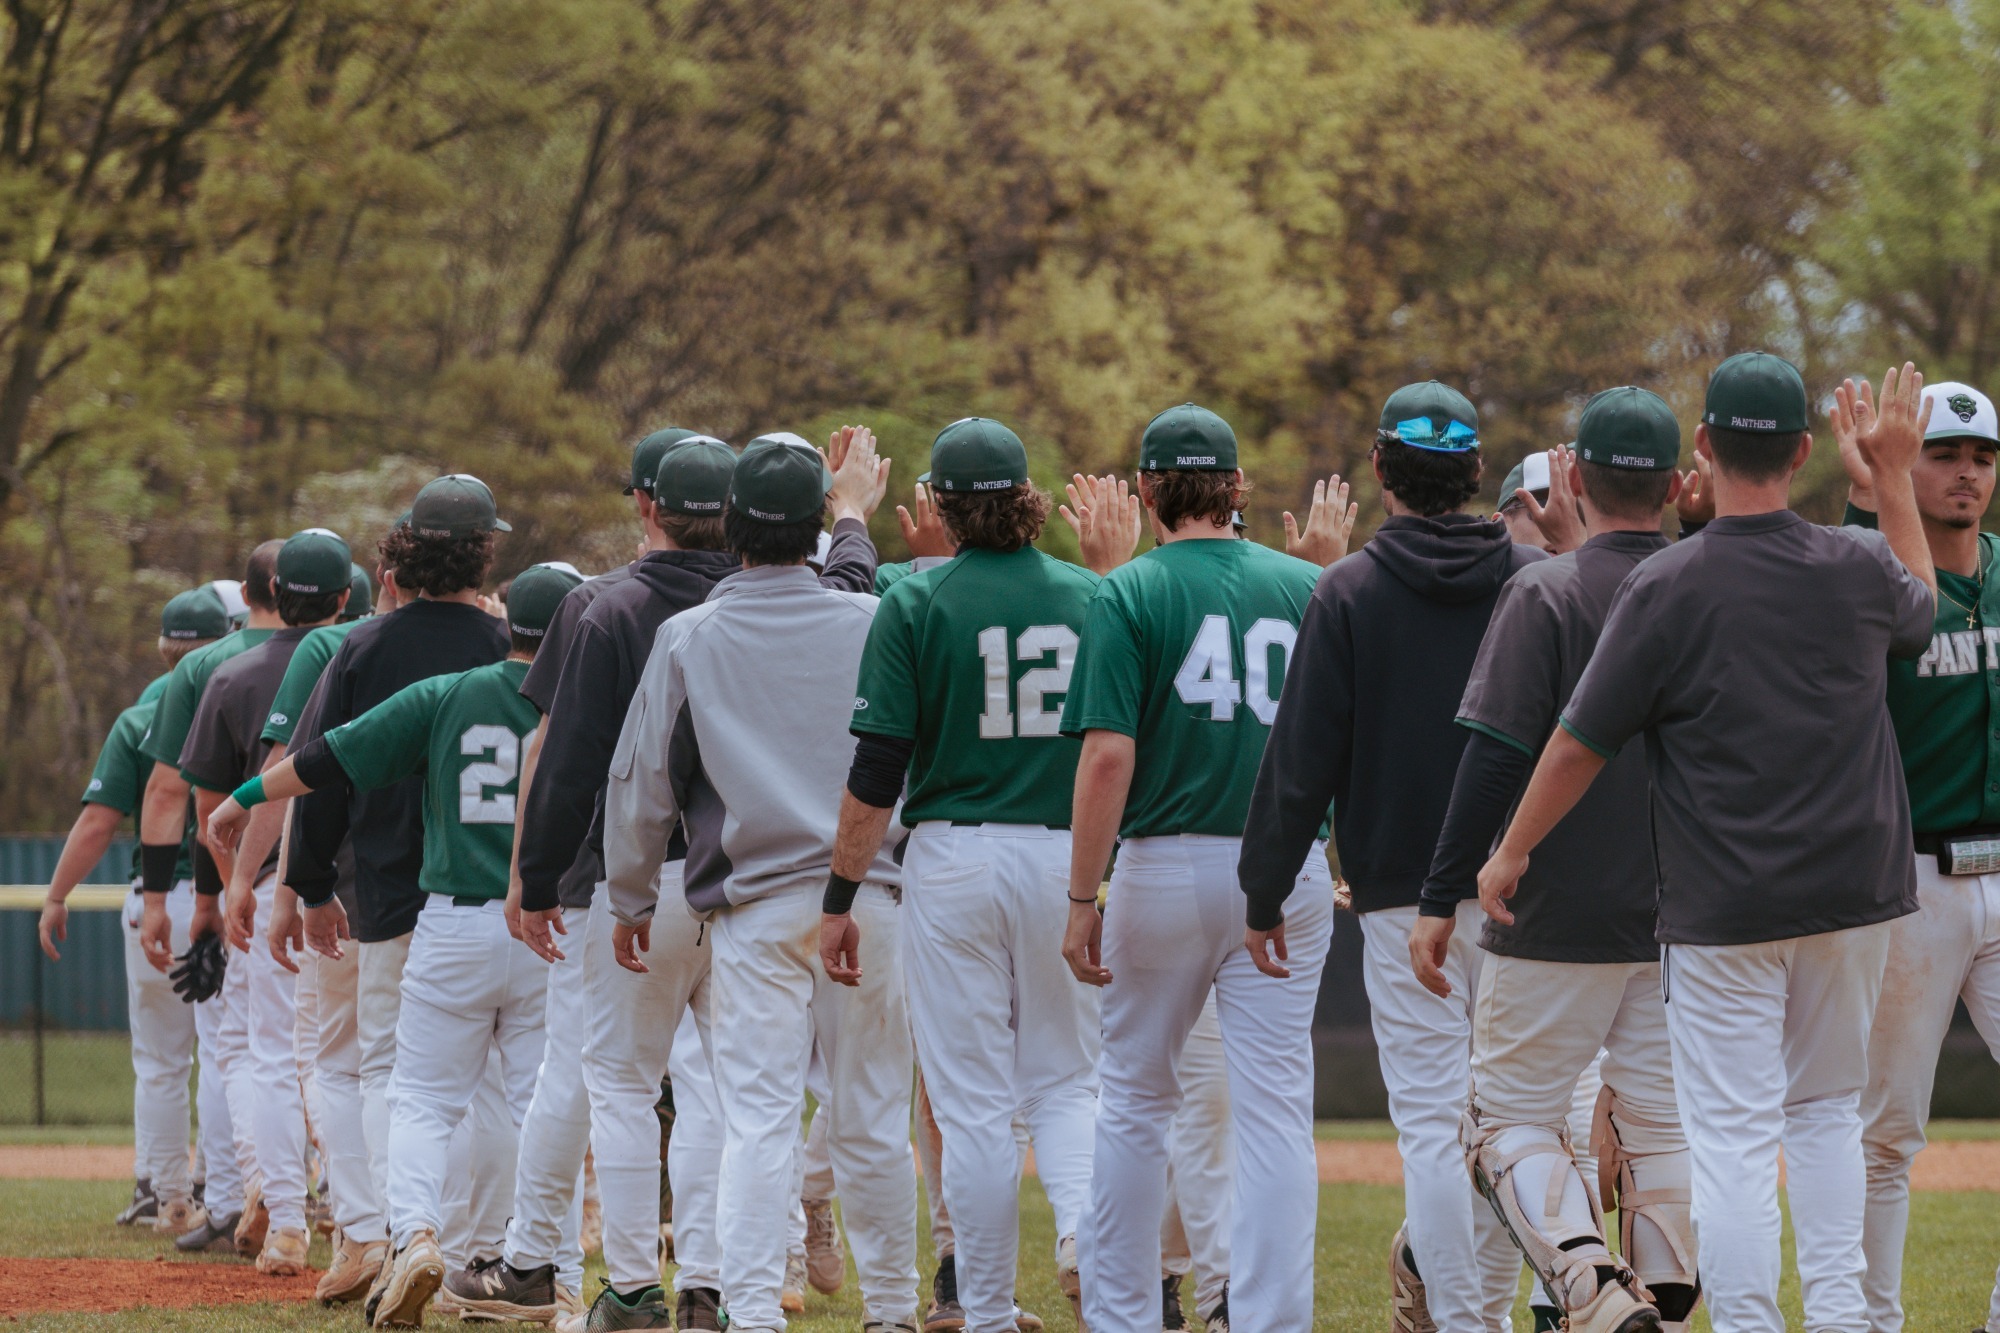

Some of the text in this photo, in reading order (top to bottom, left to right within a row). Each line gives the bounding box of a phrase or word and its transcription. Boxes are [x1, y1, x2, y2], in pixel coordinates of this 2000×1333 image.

[1731, 416, 1777, 429] PANTHERS
[1176, 456, 1217, 465] PANTHERS
[1612, 454, 1655, 467] PANTHERS
[973, 479, 1012, 490] PANTHERS
[684, 500, 721, 510] PANTHERS
[748, 506, 785, 521] PANTHERS
[1173, 614, 1299, 726] 40
[978, 624, 1081, 739] 12
[459, 723, 538, 824] 2
